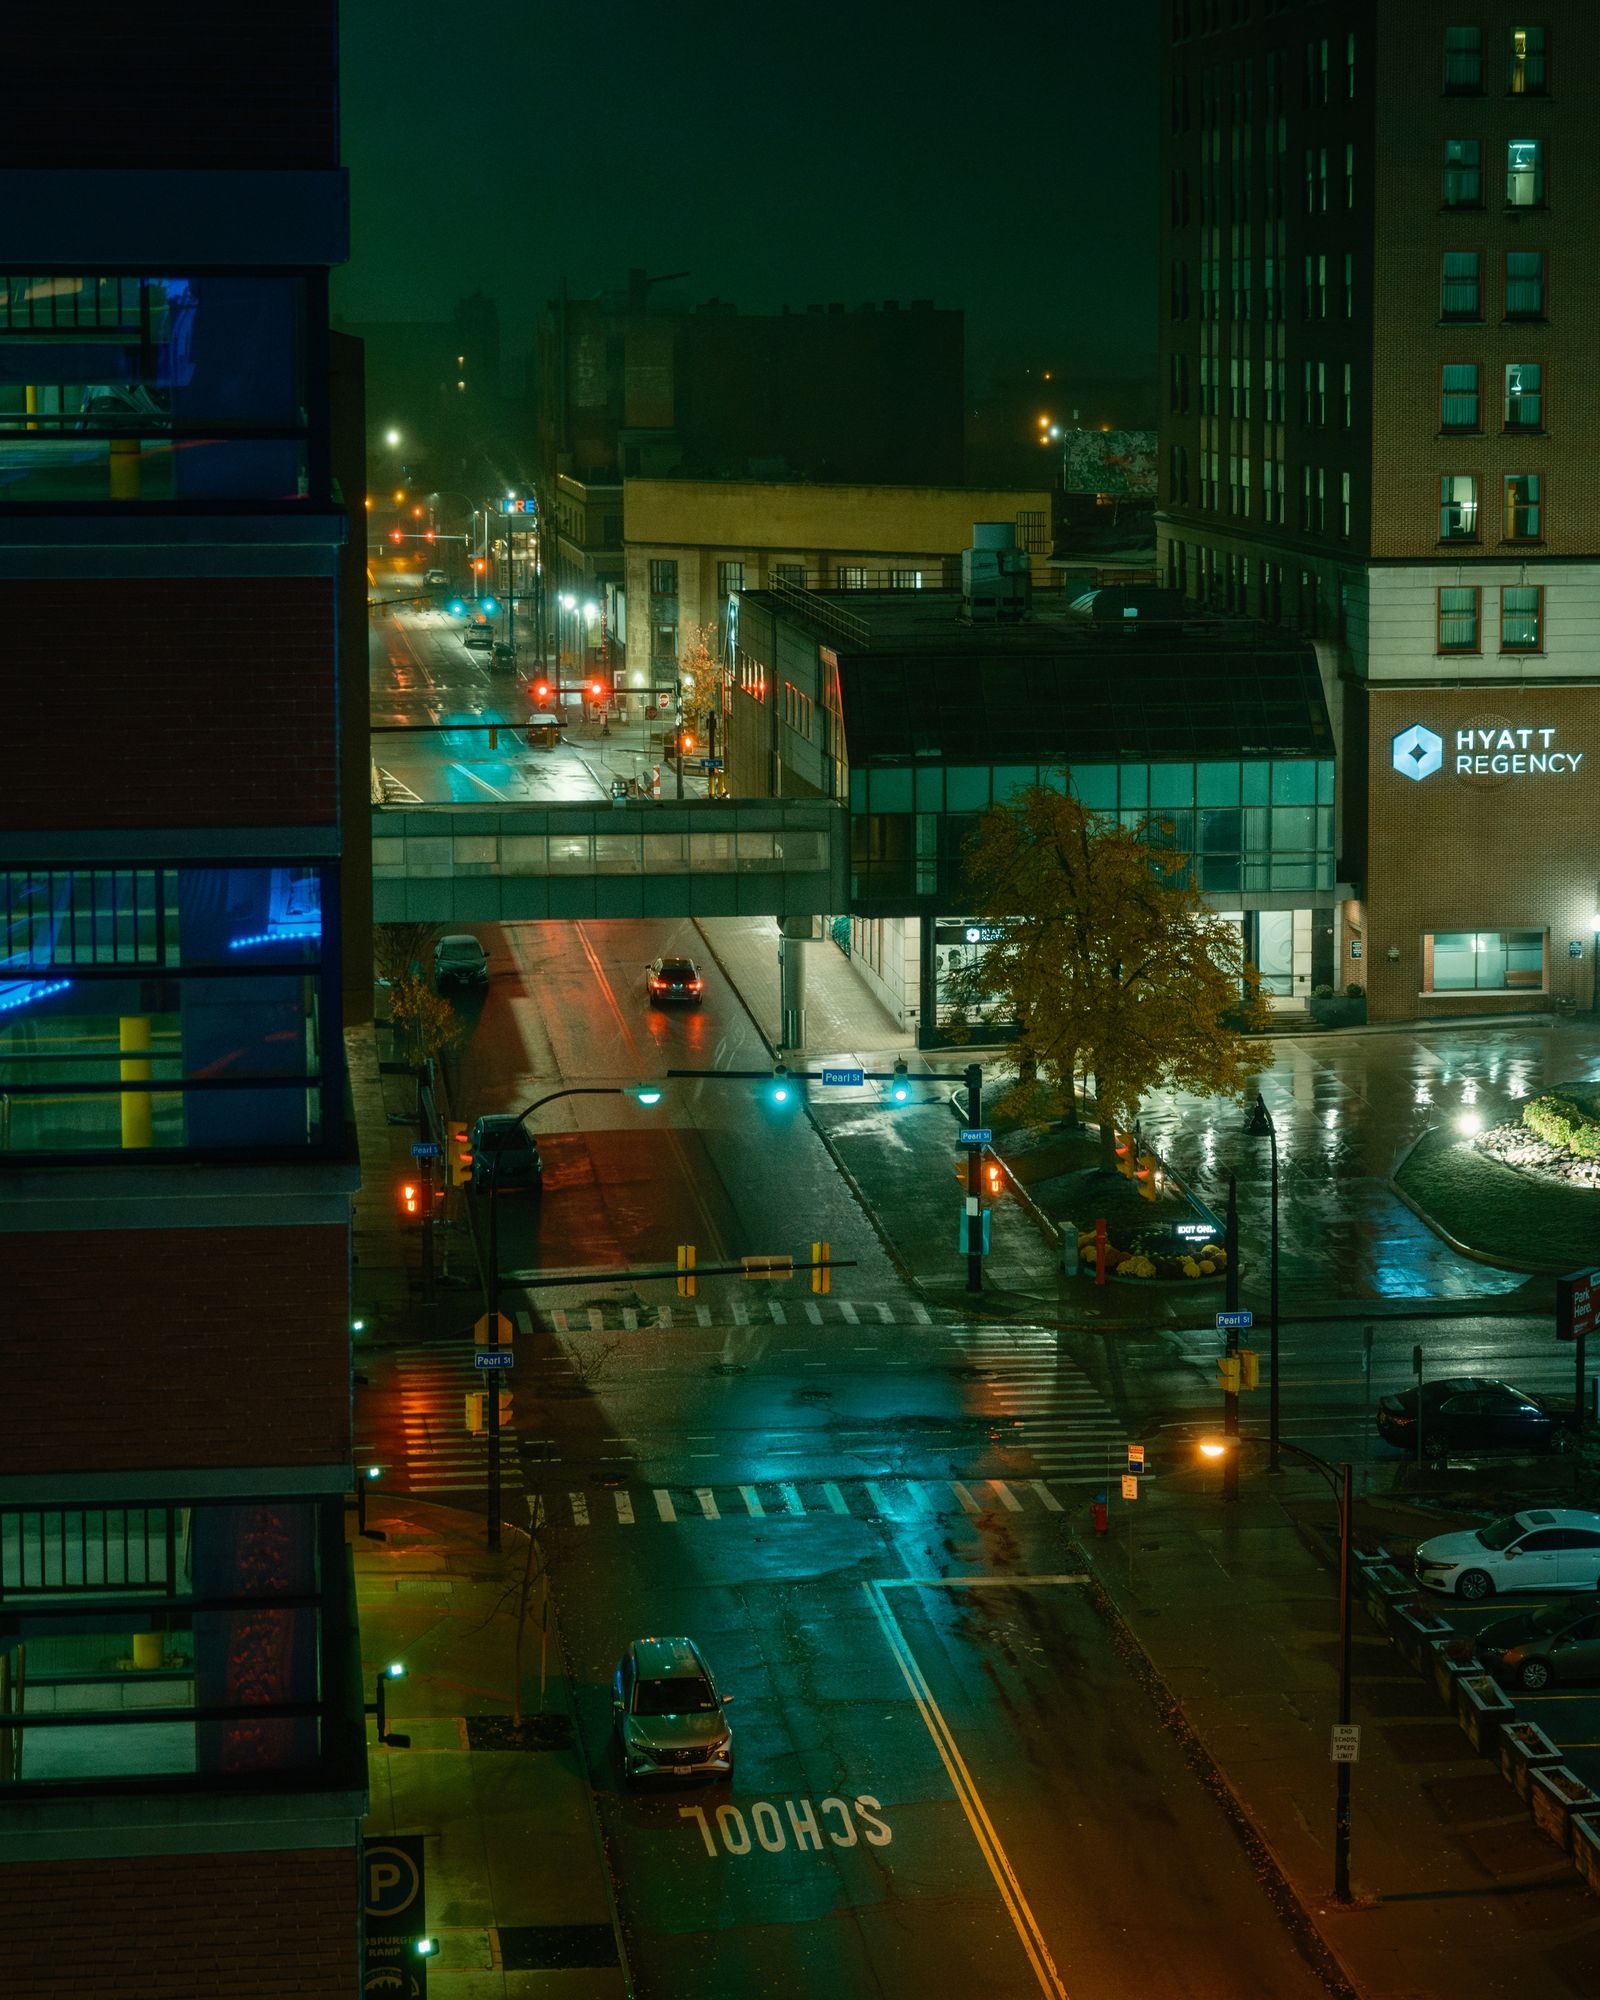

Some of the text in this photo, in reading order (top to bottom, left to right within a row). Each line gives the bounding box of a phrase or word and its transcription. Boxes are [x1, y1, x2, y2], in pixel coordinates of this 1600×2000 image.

[1457, 729, 1555, 750] HYATT
[1457, 753, 1582, 774] REGENCY
[826, 1072, 860, 1082] Pearl St
[962, 1132, 982, 1140] Pearl
[413, 1145, 432, 1154] Pearl
[1574, 1287, 1591, 1304] Park
[1218, 1316, 1240, 1325] Pearl
[477, 1356, 511, 1365] Pearl St
[678, 1795, 892, 1857] SCHOOL
[370, 1863, 401, 1902] P
[368, 1948, 401, 1957] RAMP
